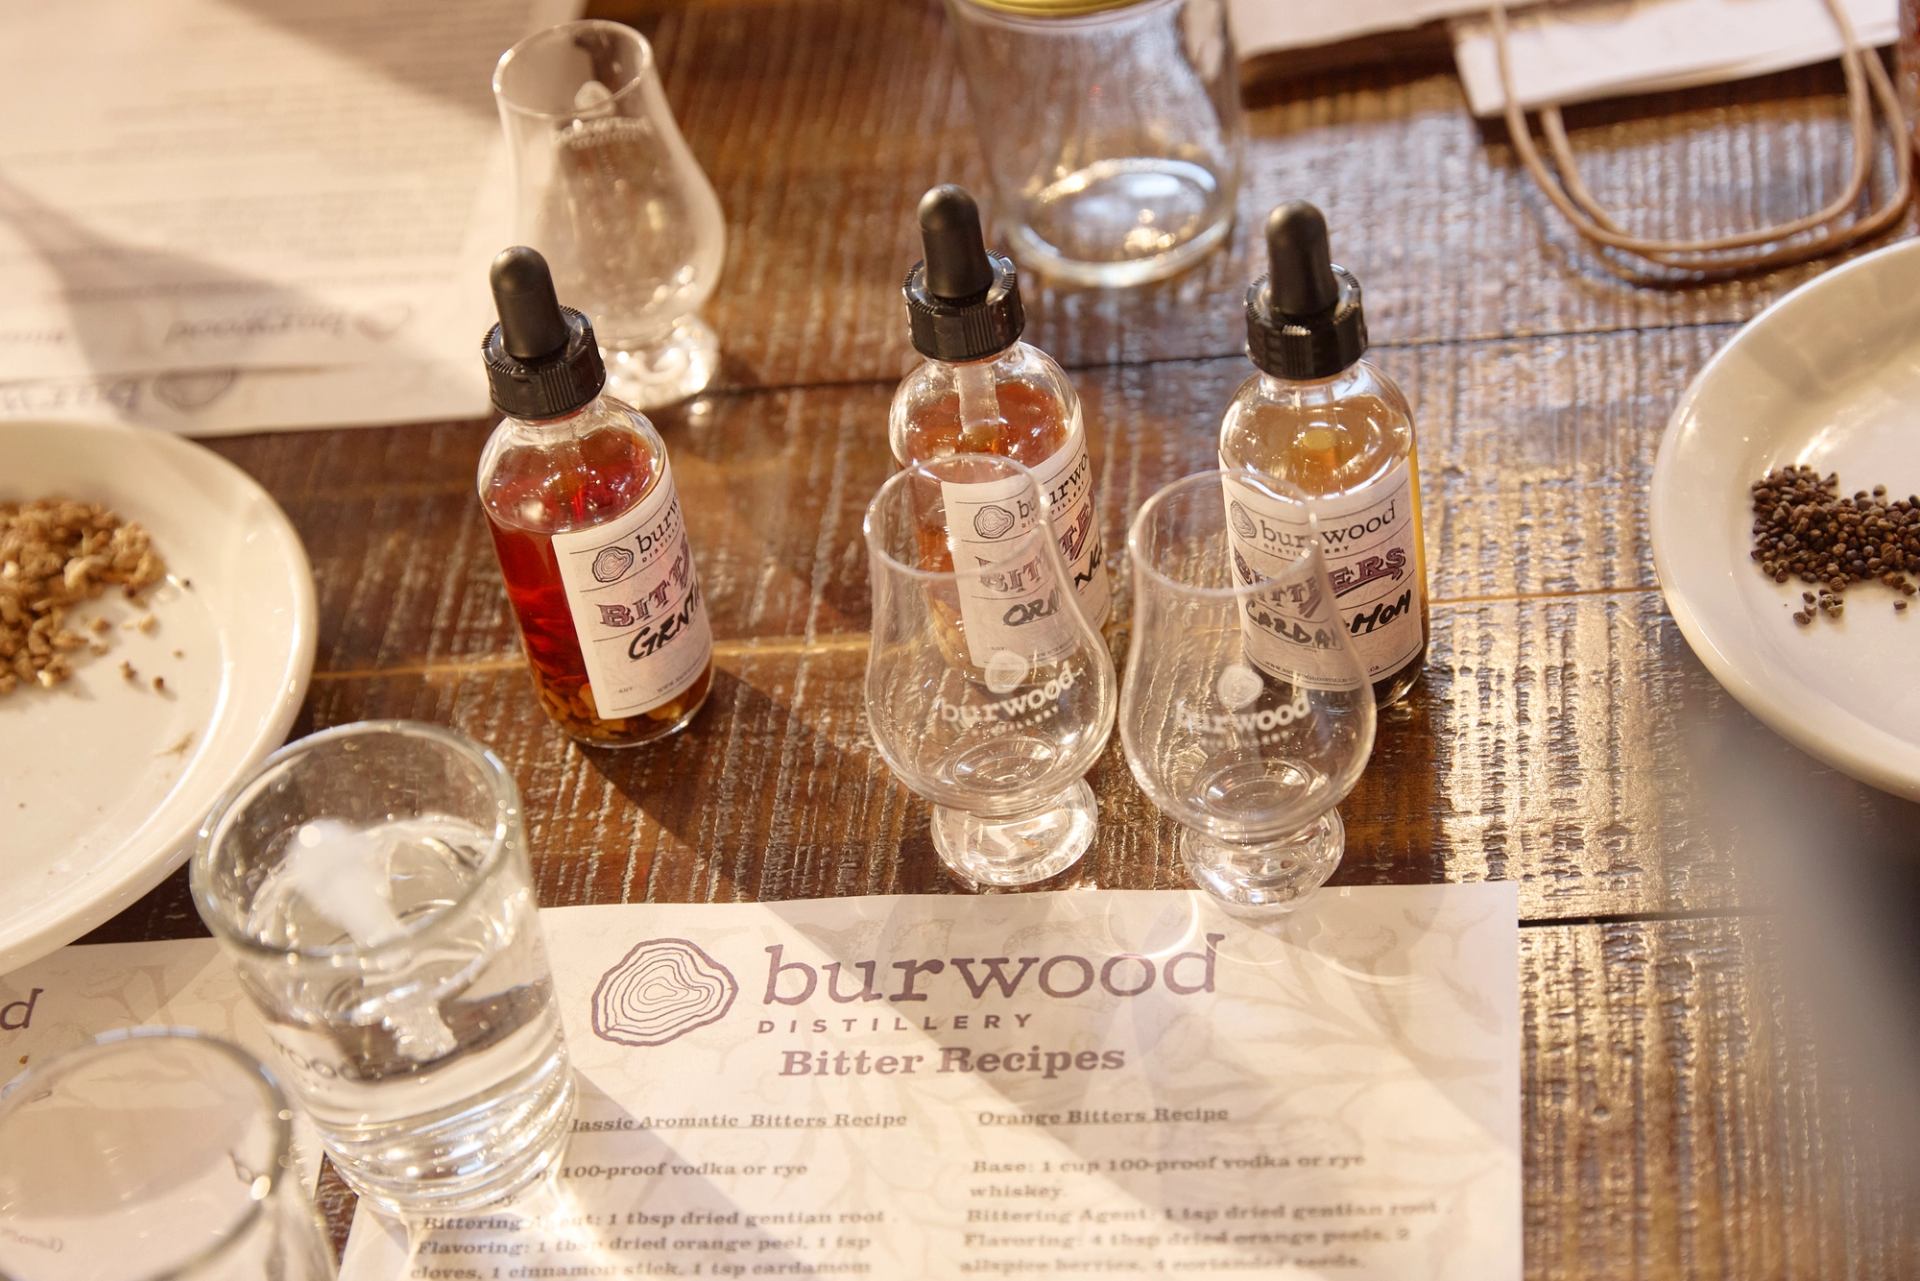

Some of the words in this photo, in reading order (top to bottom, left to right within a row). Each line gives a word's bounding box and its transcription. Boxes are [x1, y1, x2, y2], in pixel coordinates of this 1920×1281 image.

[1260, 499, 1395, 548] burwood
[1263, 543, 1350, 556] DISTIERY
[764, 933, 1226, 1005] burwood
[758, 1013, 1033, 1034] DISTILLERY
[778, 1048, 924, 1077] Bitter
[936, 1045, 1125, 1079] Recipes
[571, 1118, 635, 1133] lassic
[638, 1114, 739, 1131] Aromatic
[750, 1113, 827, 1129] Bitters
[834, 1112, 908, 1129] Recipe
[978, 1111, 1062, 1126] Orange
[1067, 1108, 1147, 1124] Bitters
[1154, 1106, 1230, 1123] Recipe
[562, 1162, 668, 1180] 100-proof
[671, 1163, 737, 1176] vodka
[743, 1164, 768, 1175] or
[772, 1164, 808, 1178] rye
[973, 1160, 1035, 1173] Base:
[1042, 1160, 1052, 1173] 1
[1060, 1161, 1100, 1176] cup
[1108, 1155, 1218, 1176] 100-proof
[1221, 1154, 1291, 1170] vodka
[1297, 1154, 1321, 1167] or
[1328, 1153, 1367, 1170] rye
[423, 1216, 522, 1232] Bittering
[627, 1209, 675, 1228] tbsp
[680, 1211, 739, 1226] dried
[744, 1212, 832, 1228] gentian
[838, 1209, 886, 1225] root
[1225, 1205, 1286, 1219] dried
[608, 1237, 670, 1252] dried
[673, 1237, 752, 1252] orange
